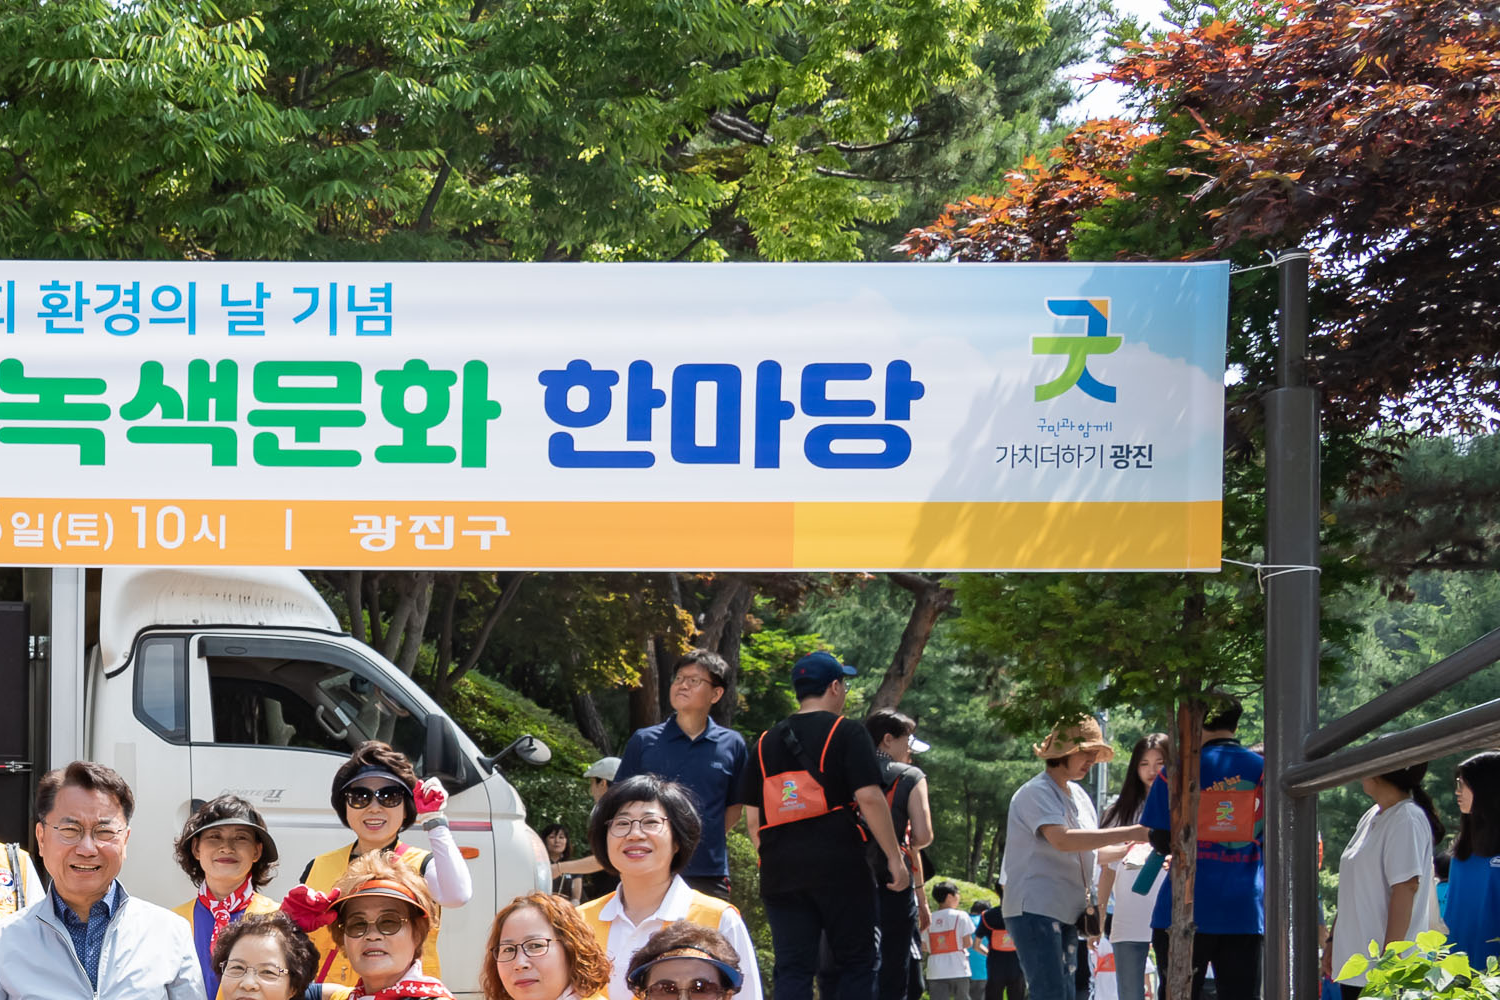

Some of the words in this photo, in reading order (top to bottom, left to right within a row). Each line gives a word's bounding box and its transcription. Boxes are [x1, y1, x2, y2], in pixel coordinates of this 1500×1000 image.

[38, 280, 197, 336] 환경의
[220, 282, 272, 336] 날
[291, 282, 393, 336] 기념
[538, 359, 925, 469] 한마당
[1036, 418, 1075, 437] 구민과
[1078, 421, 1113, 438] 함께
[996, 444, 1105, 470] 가치더하기
[1109, 444, 1153, 470] 광진
[131, 505, 226, 550] 10시
[349, 514, 511, 552] 광진구
